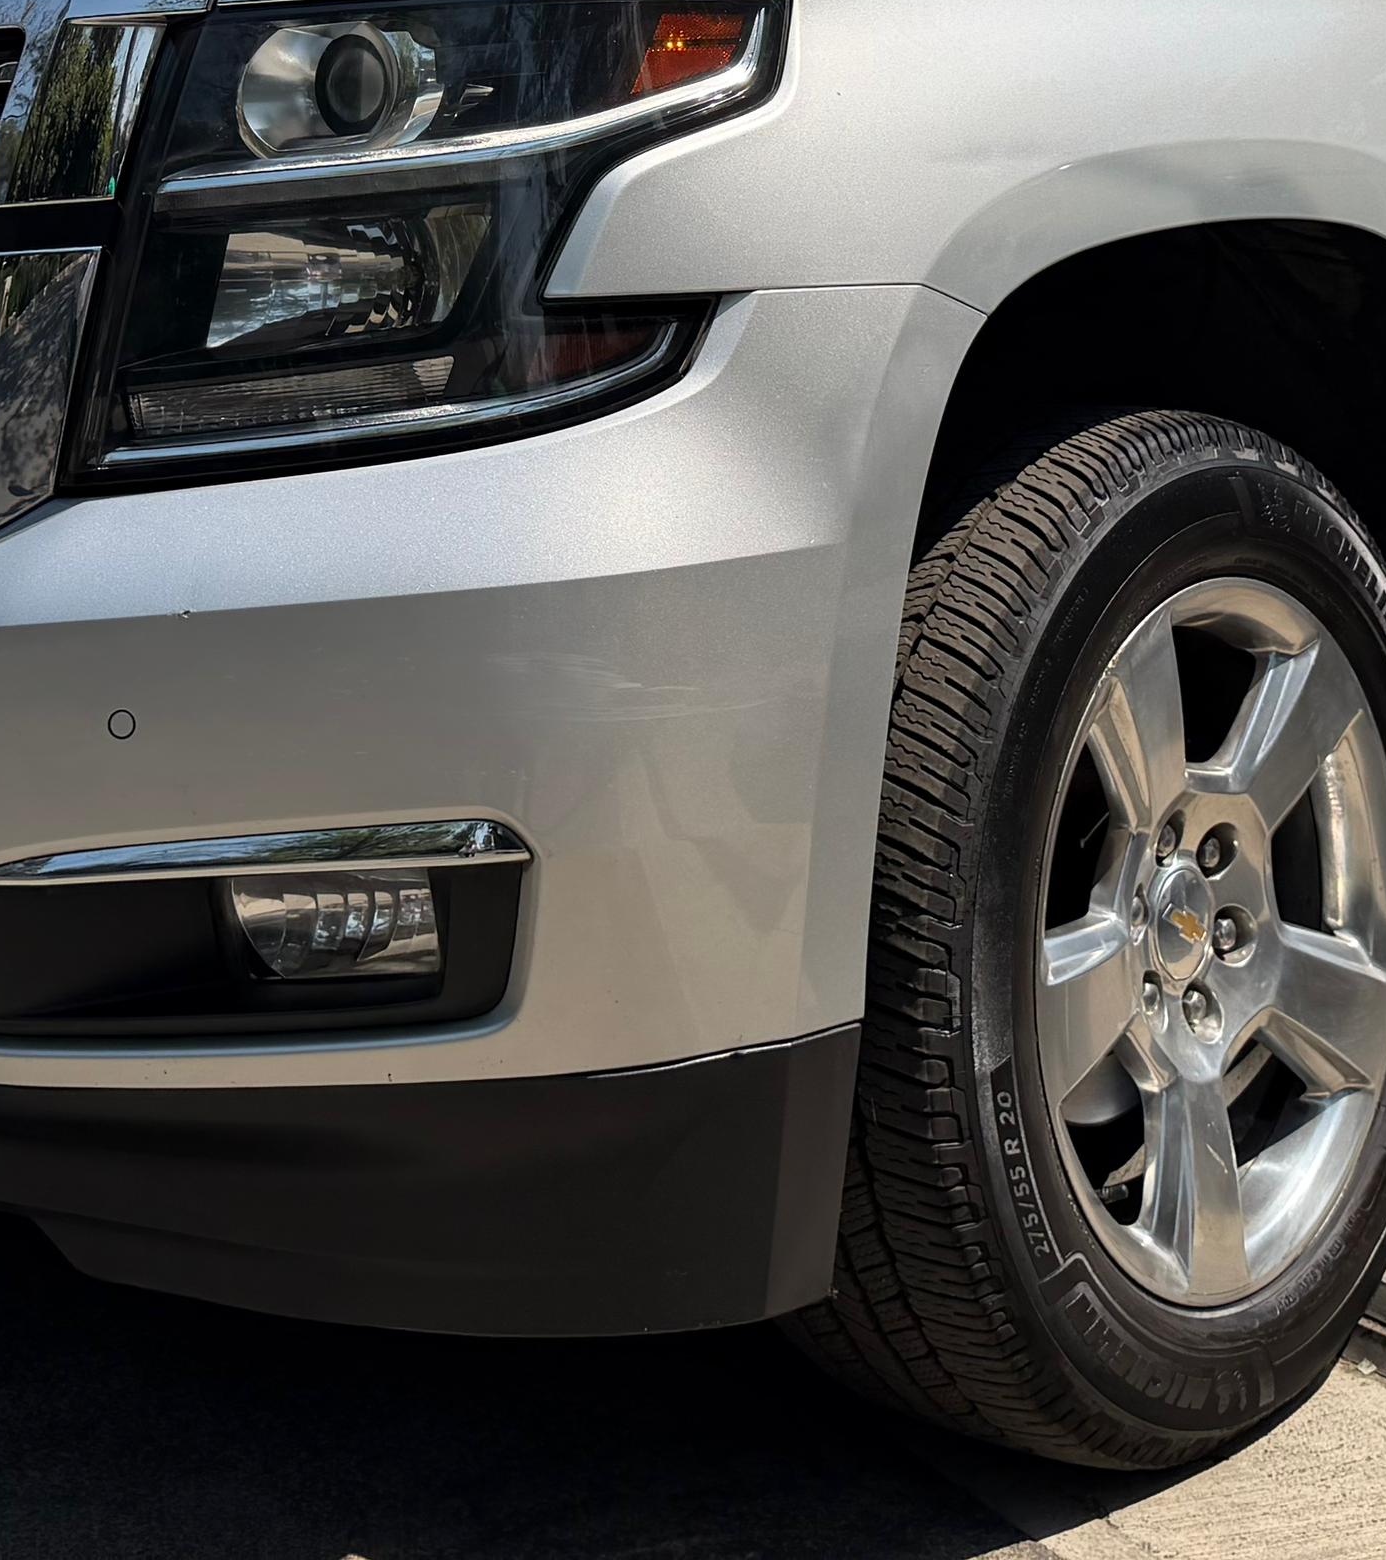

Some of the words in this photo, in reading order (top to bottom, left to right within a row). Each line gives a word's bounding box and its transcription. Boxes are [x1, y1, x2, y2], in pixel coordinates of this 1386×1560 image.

[996, 1090, 1016, 1126] 20
[1003, 1137, 1022, 1156] R
[1009, 1165, 1051, 1259] 275/55
[1065, 1292, 1214, 1411] MICHELIN
